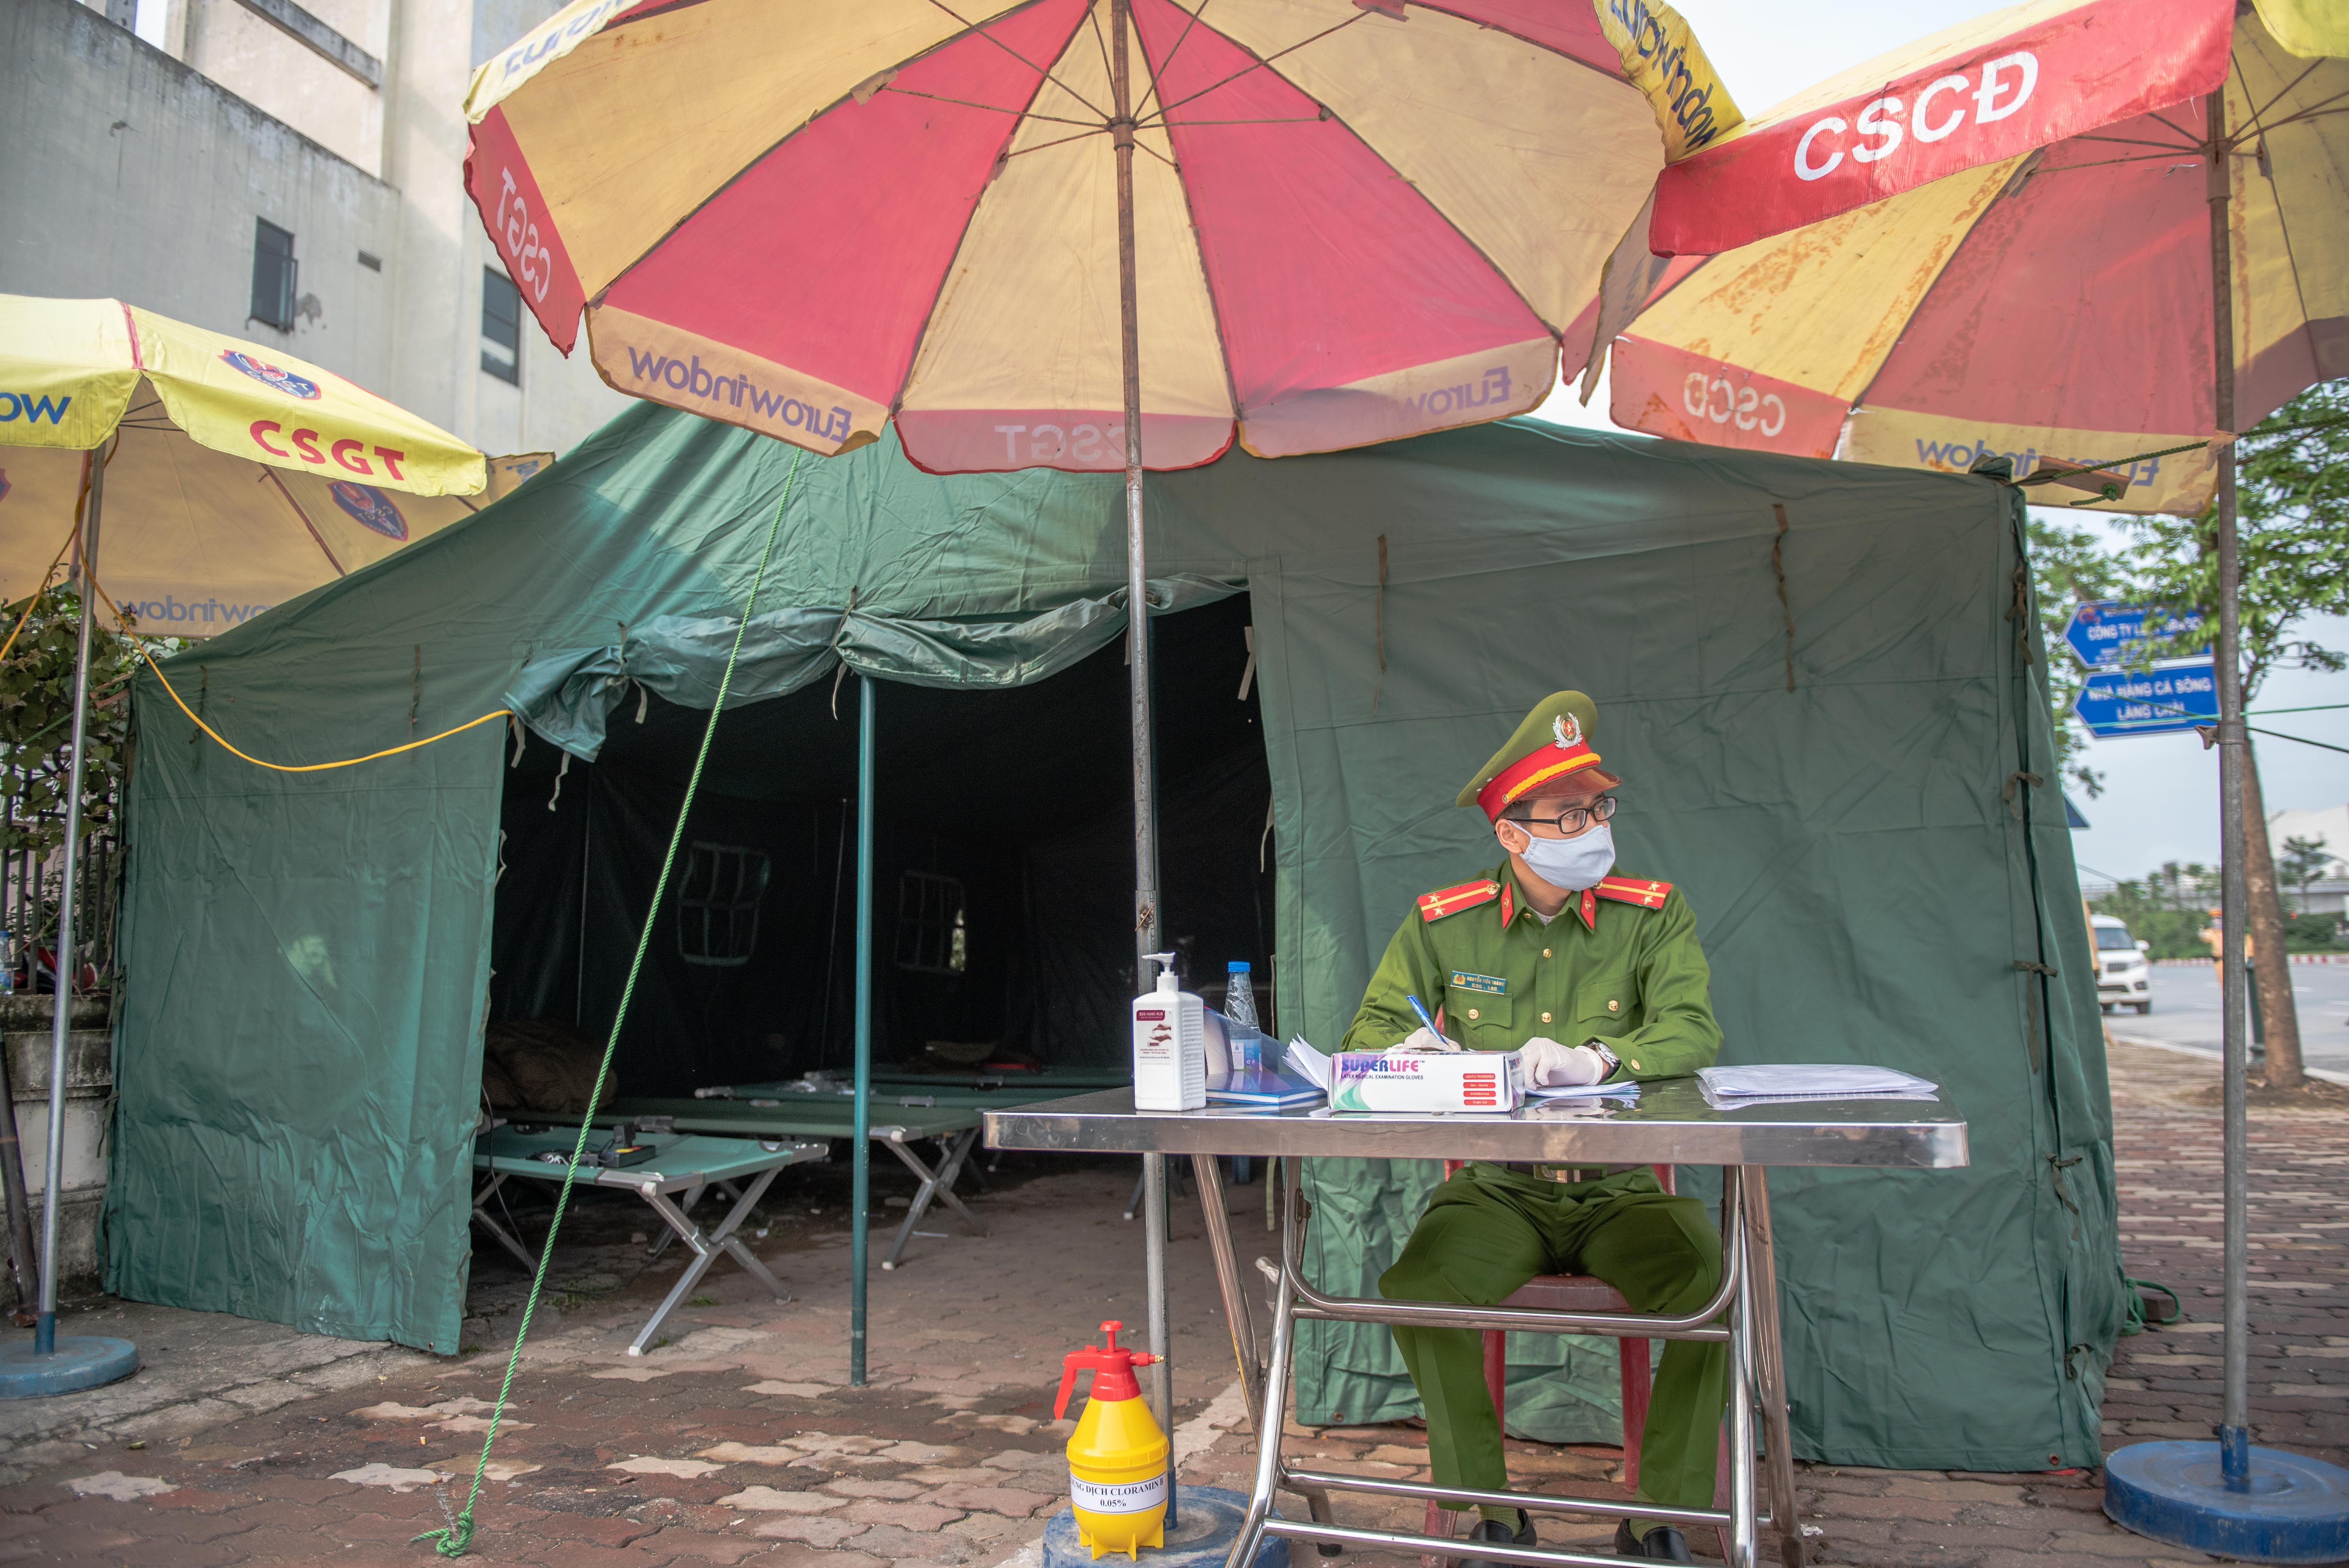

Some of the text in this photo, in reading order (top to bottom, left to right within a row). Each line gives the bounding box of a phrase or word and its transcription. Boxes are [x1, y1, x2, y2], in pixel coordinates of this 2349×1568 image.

[250, 420, 405, 481] CSGT
[1342, 1059, 1418, 1072] SUPERLIFE
[1071, 1477, 1164, 1496] DUNG DỊCH CLORAMIN B
[1100, 1499, 1126, 1507] 0.05%
